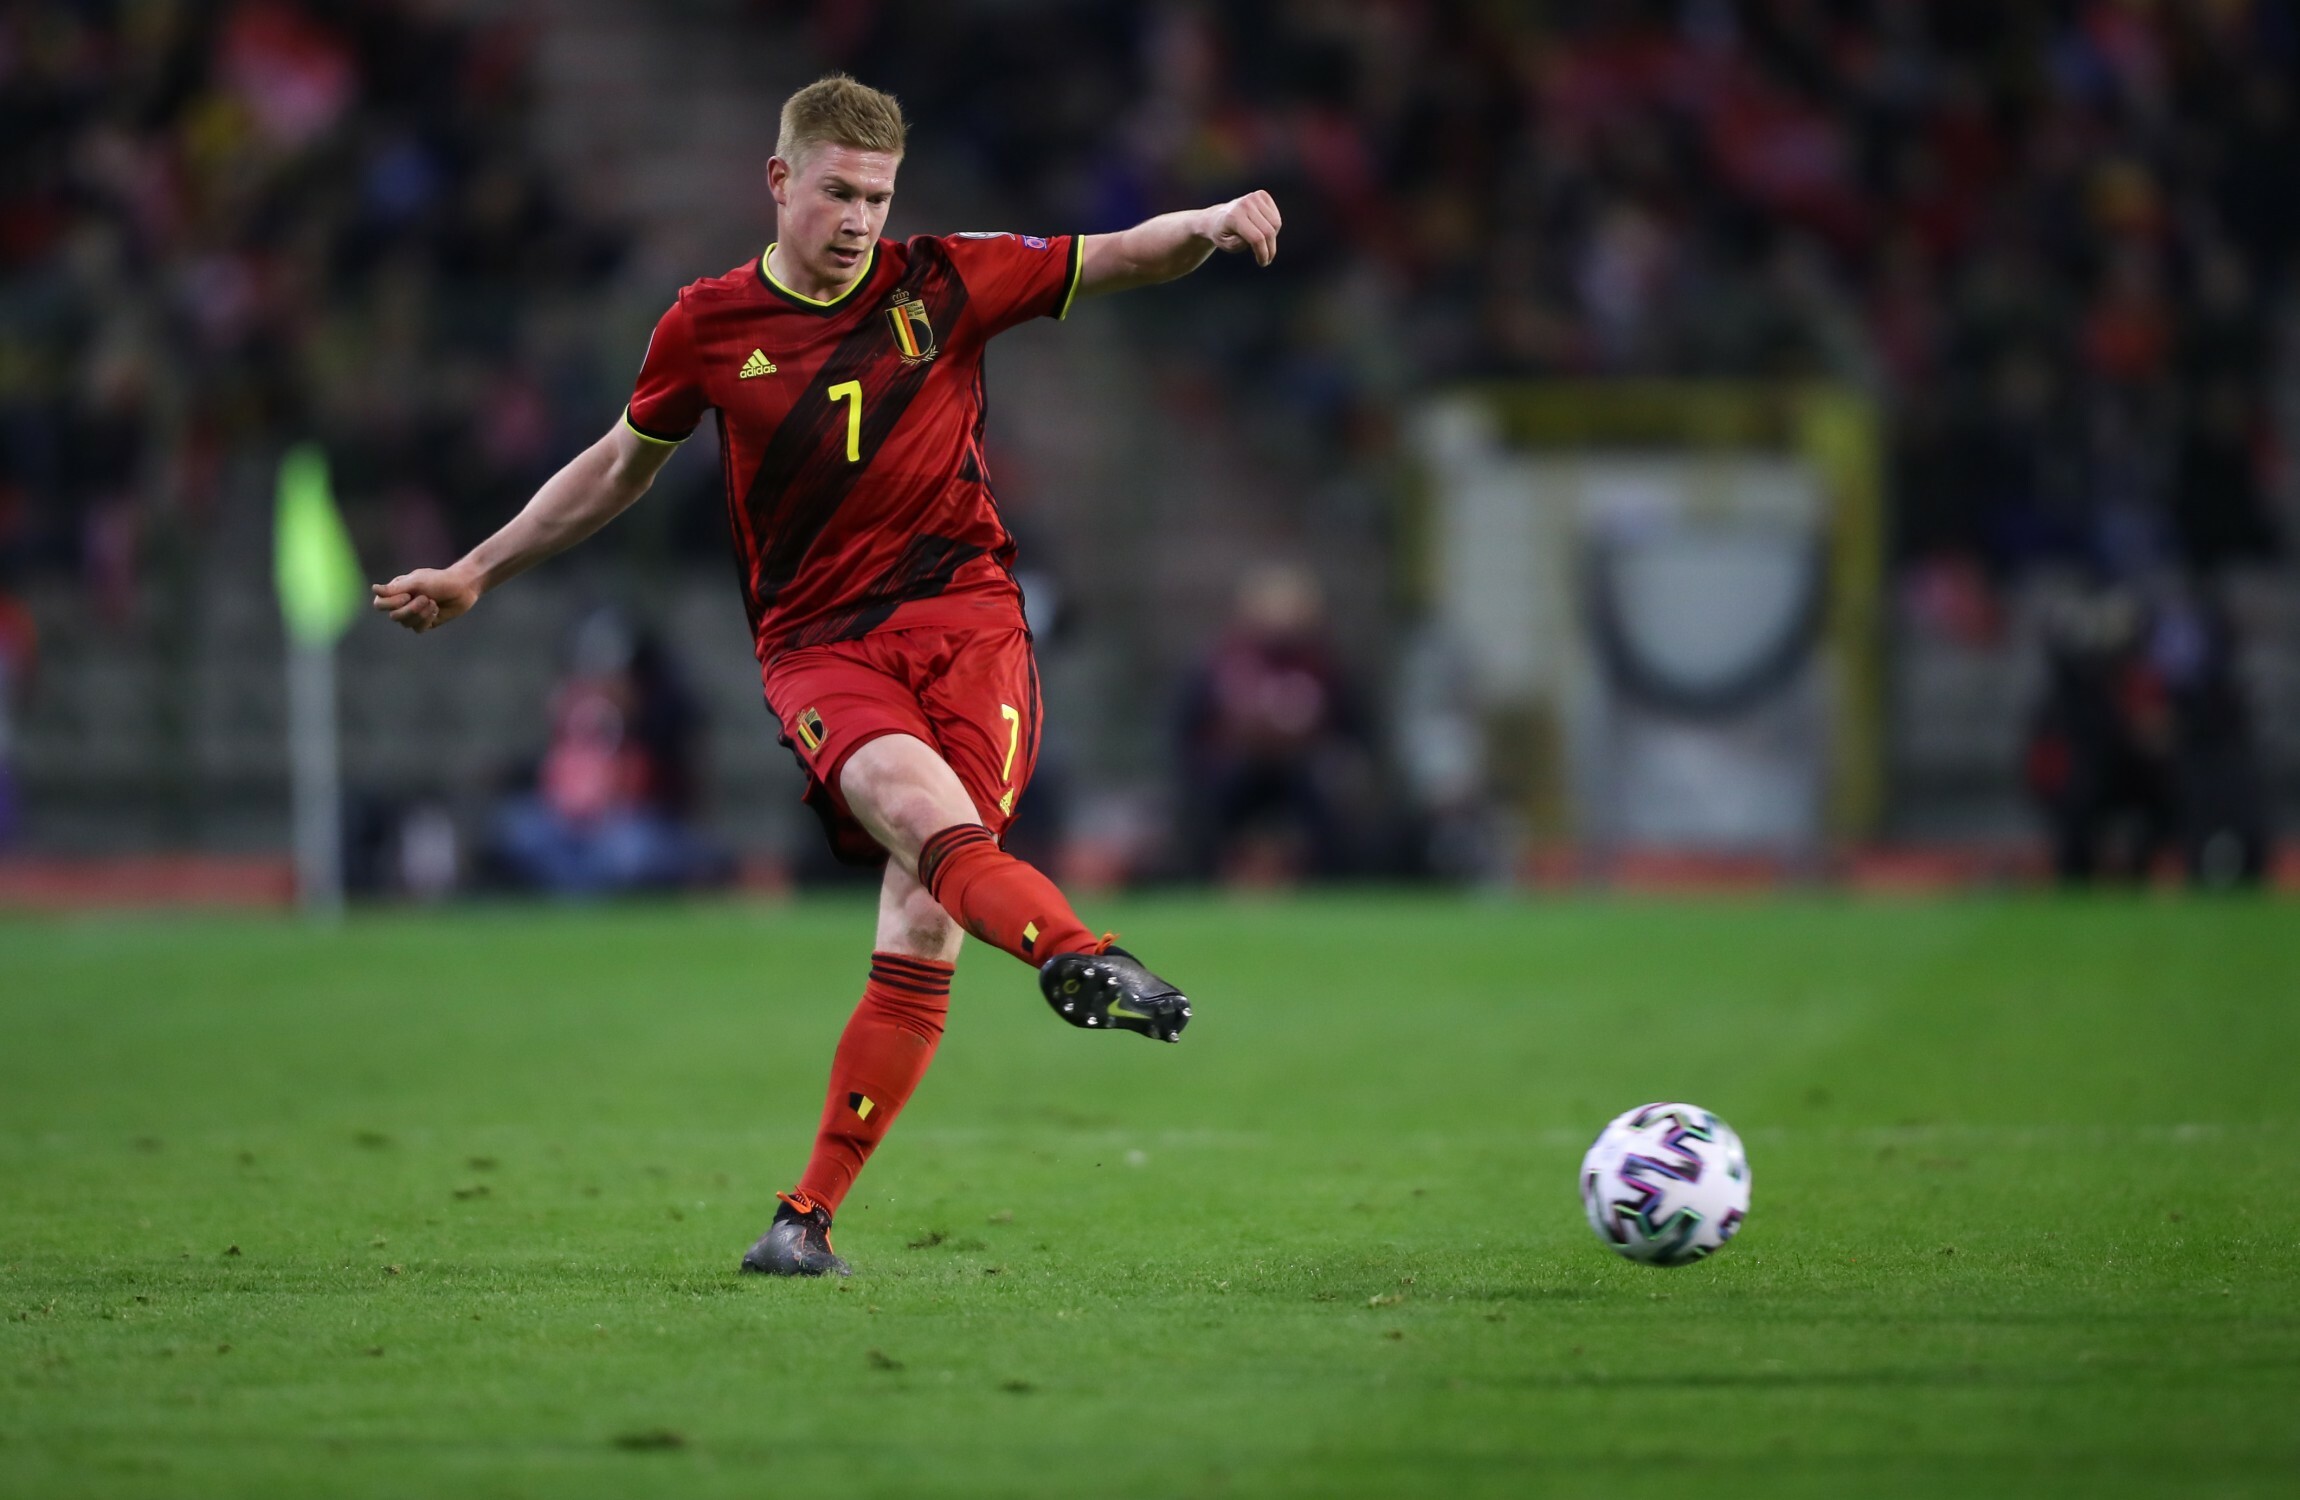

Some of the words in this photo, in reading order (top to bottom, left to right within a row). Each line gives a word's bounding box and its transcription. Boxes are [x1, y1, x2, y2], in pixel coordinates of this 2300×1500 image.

[739, 364, 777, 379] adidas
[828, 380, 862, 461] 7
[1001, 703, 1019, 781] 7
